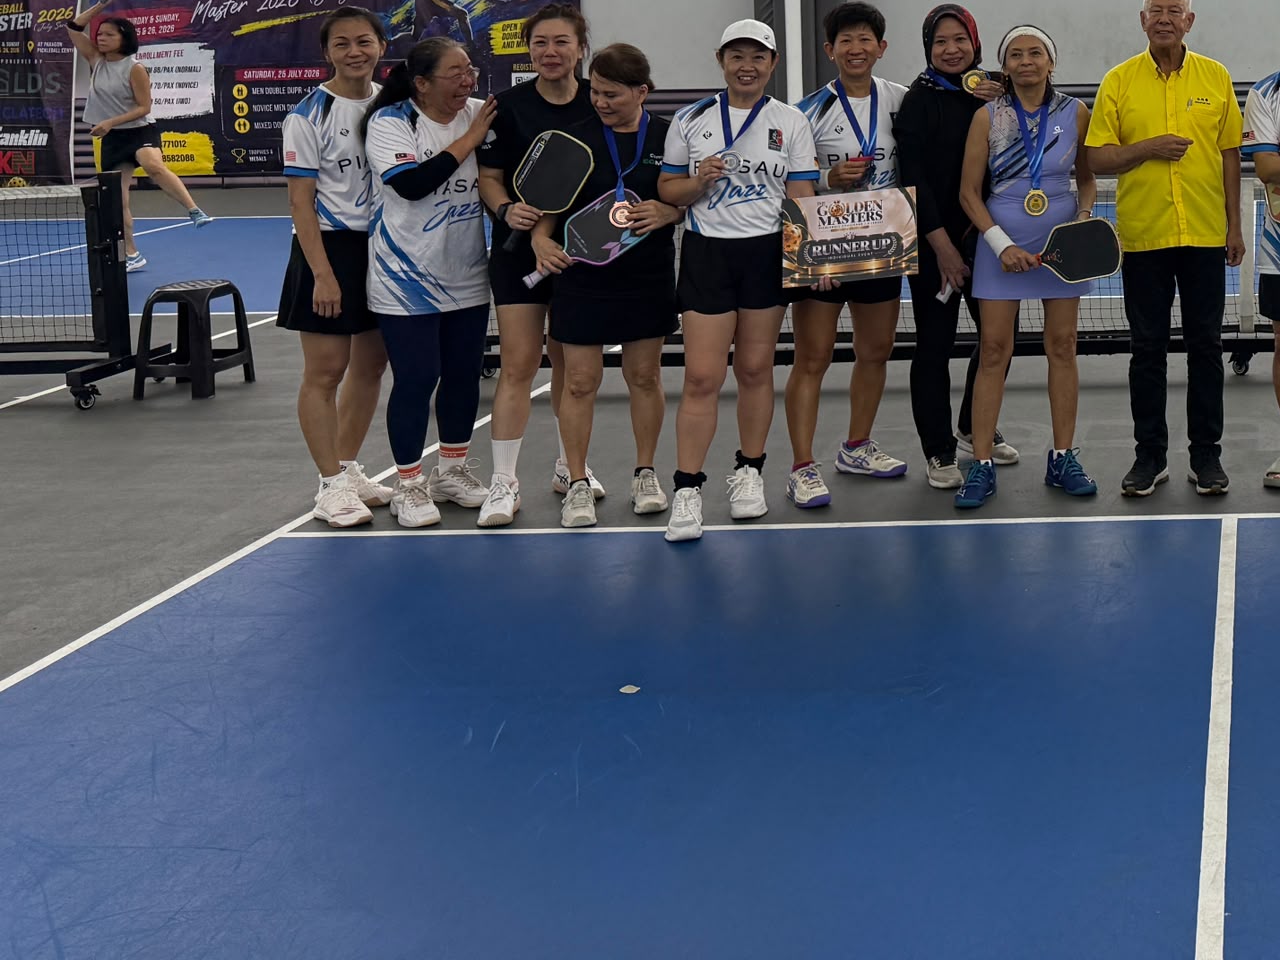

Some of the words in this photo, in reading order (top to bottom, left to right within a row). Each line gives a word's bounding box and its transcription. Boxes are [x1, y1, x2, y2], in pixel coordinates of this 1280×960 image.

[36, 6, 74, 23] 2026
[191, 0, 248, 24] Master
[501, 23, 518, 32] OPEN
[501, 40, 515, 49] AND
[173, 49, 184, 58] FEE
[243, 70, 277, 79] SATURDAY,
[287, 69, 302, 78] JULY
[251, 87, 264, 95] MEN
[252, 104, 273, 112] NOVICE
[708, 176, 767, 210] Jazz
[818, 210, 883, 227] MASTERS
[812, 240, 870, 257] RUNNER
[872, 238, 891, 250] UP
